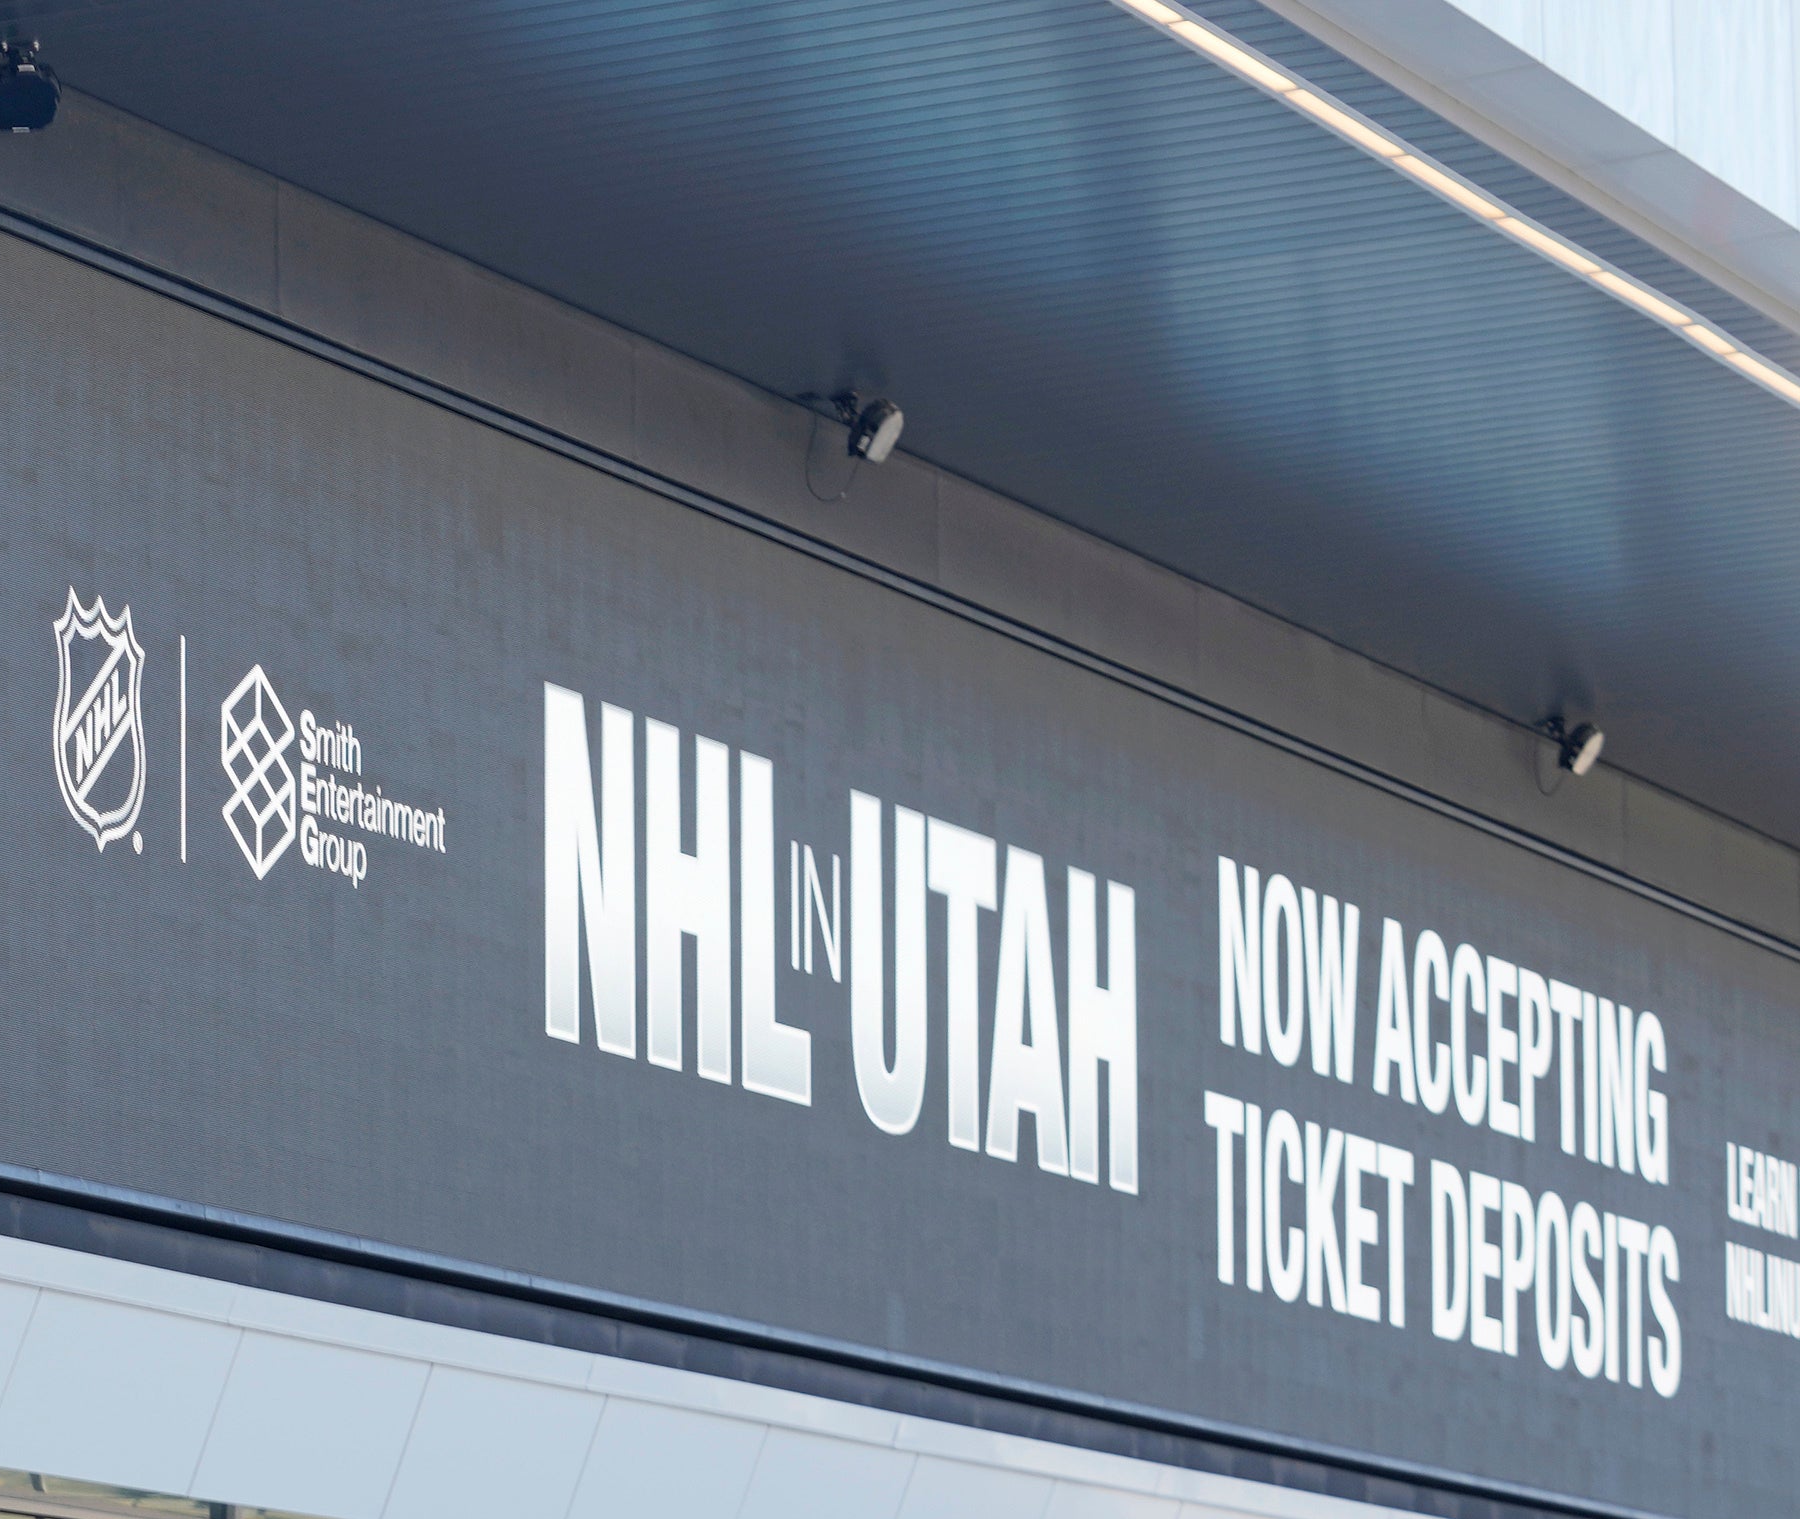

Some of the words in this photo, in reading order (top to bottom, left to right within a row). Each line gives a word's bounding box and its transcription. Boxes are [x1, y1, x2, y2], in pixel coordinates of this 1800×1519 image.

[75, 668, 127, 784] NHL
[299, 708, 363, 776] Smith
[299, 762, 447, 854] Entertainment
[299, 814, 368, 890] Group
[544, 679, 813, 1108] NHL
[790, 838, 842, 983] IN
[849, 787, 1140, 1196] UTAH
[1217, 854, 1361, 1085] NOW
[1372, 916, 1669, 1186] ACCEPTING
[1203, 1088, 1415, 1329] TICKET
[1429, 1158, 1682, 1399] DEPOSITS
[1725, 1140, 1799, 1241] LEARN
